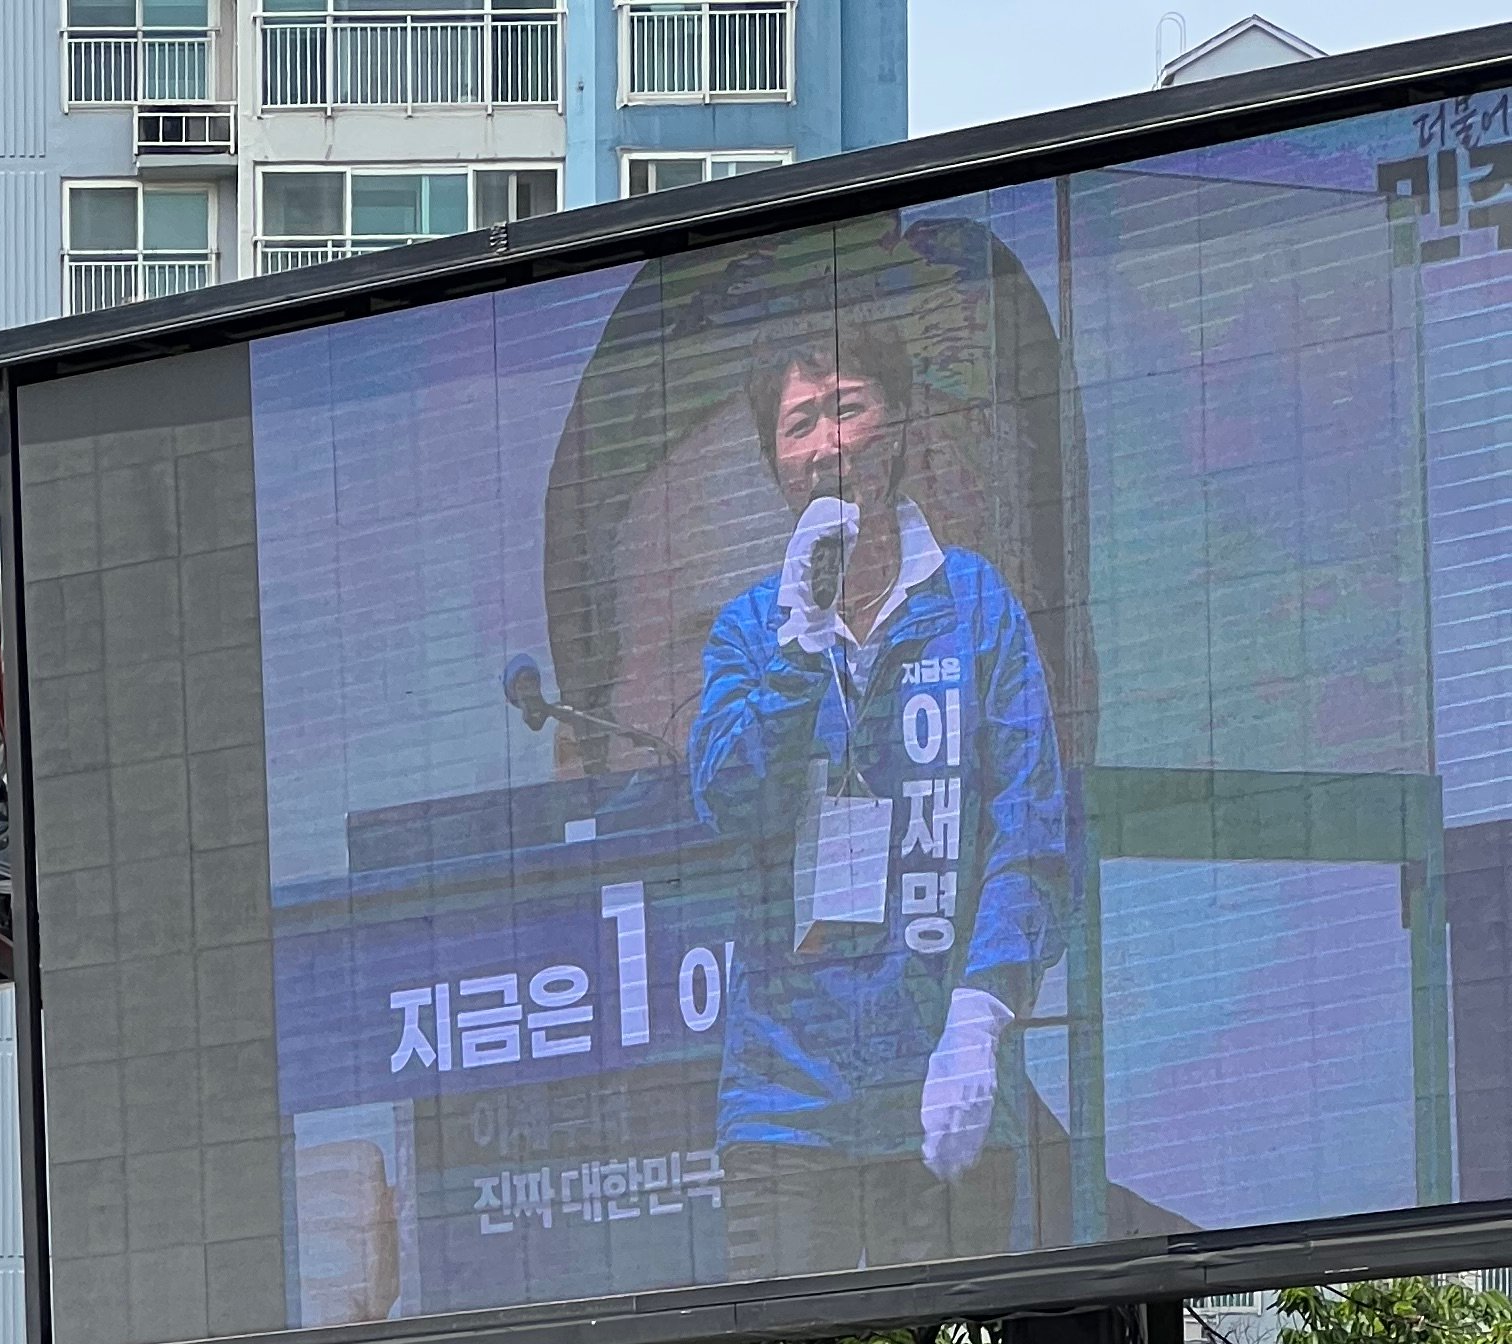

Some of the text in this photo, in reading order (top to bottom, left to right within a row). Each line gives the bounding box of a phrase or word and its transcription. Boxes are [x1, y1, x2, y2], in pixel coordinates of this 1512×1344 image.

[902, 657, 961, 684] 지금은
[901, 687, 961, 953] 이재명
[390, 965, 594, 1074] 지금은
[601, 880, 650, 1048] 1
[473, 1149, 726, 1235] 진짜 대한민국
